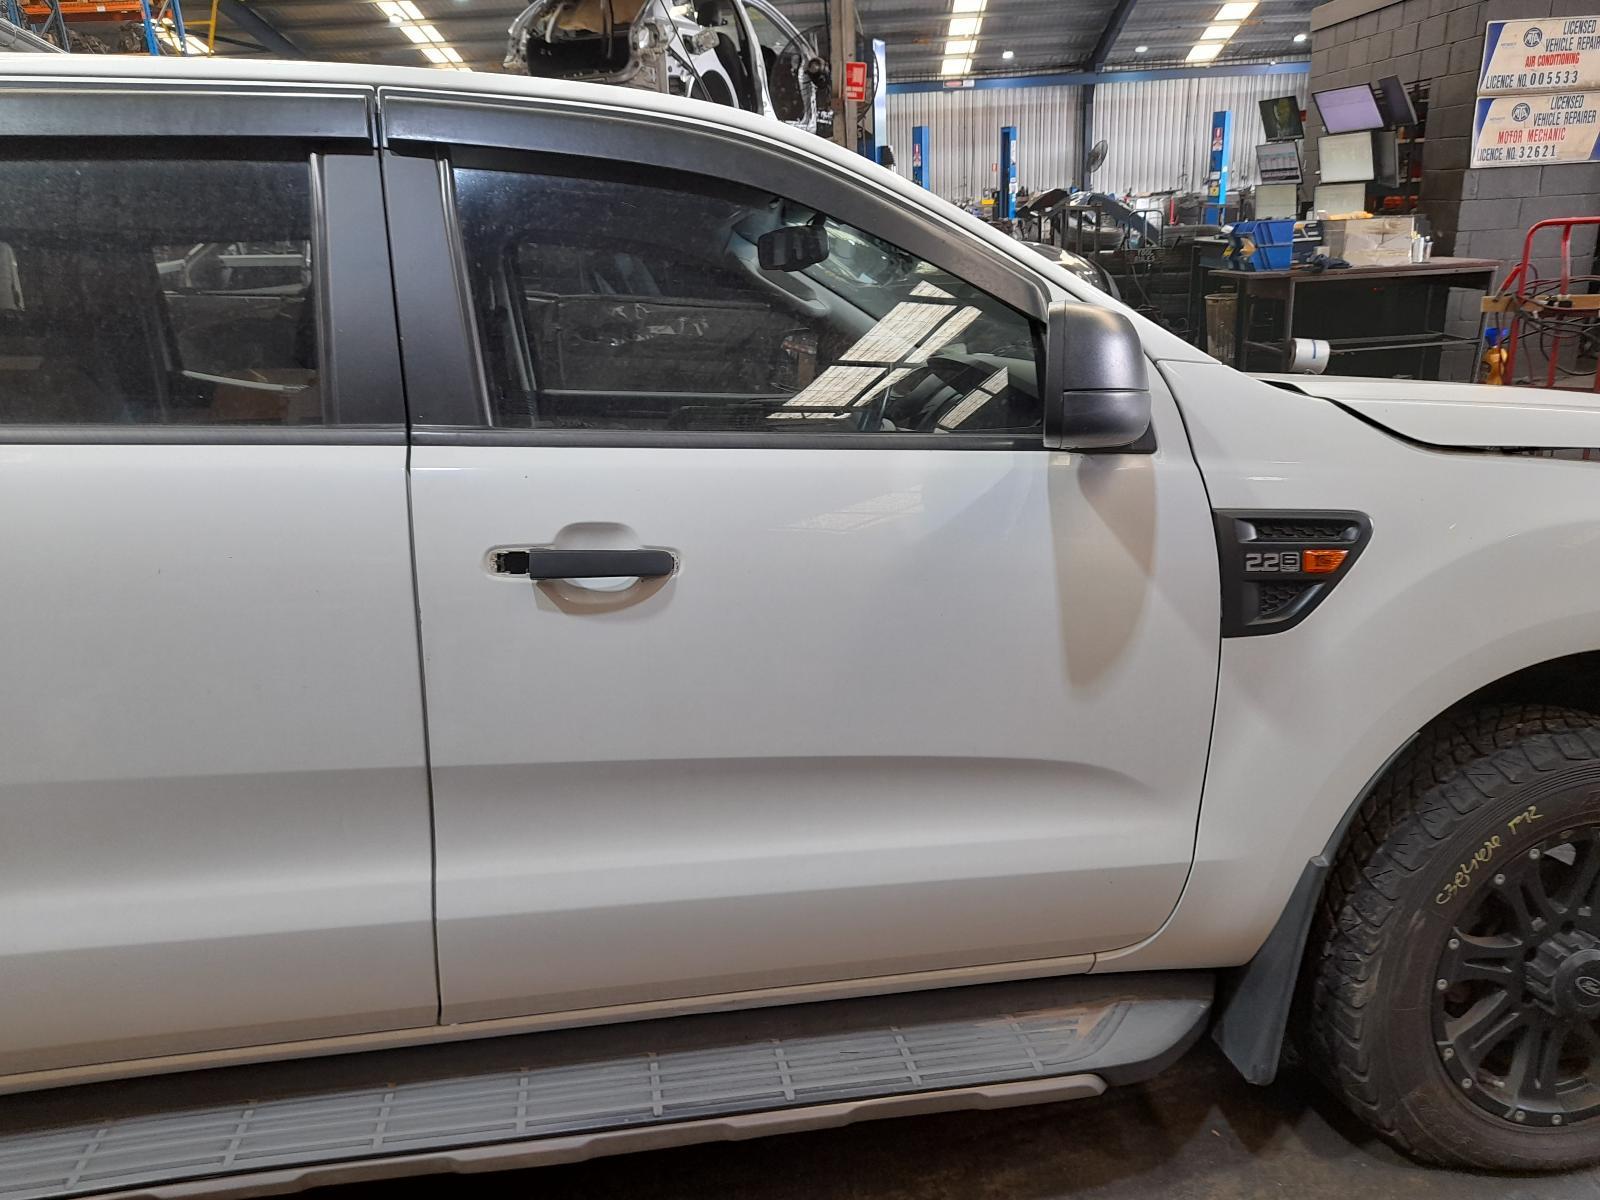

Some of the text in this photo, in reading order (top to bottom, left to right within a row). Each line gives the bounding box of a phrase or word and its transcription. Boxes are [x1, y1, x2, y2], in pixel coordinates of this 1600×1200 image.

[1563, 20, 1597, 35] LICENSED
[1546, 37, 1573, 51] VEHICLE
[1525, 52, 1580, 68] AIR CONDITIONING
[1486, 75, 1514, 89] LICENCE
[1530, 70, 1578, 86] 005533
[1550, 95, 1584, 110] LICENSED
[1534, 110, 1597, 126] VEHICLE REPAIRER
[1497, 128, 1566, 144] MOTOR MECHANIC
[1477, 148, 1503, 161] LICENCE
[1518, 144, 1556, 158] 32621
